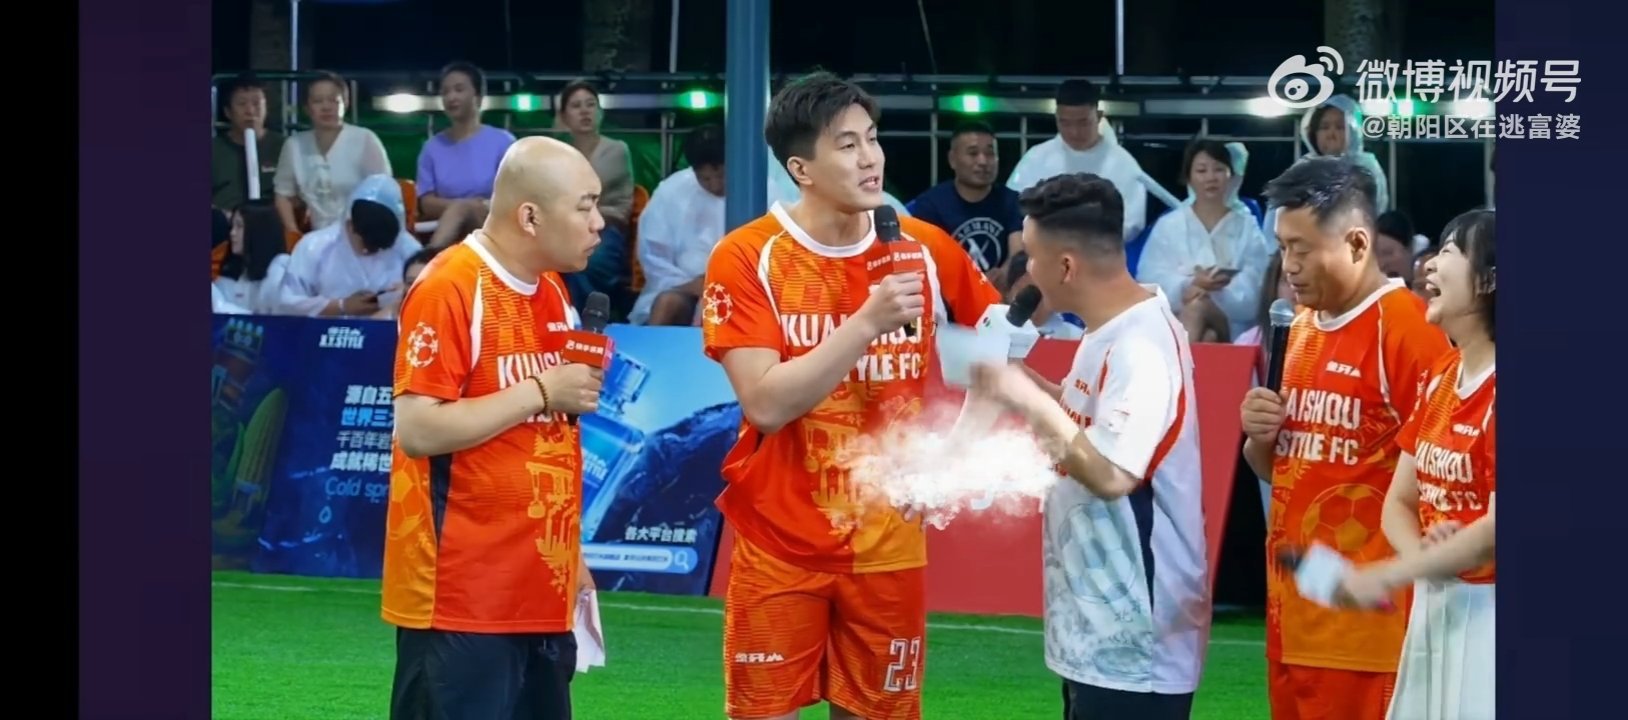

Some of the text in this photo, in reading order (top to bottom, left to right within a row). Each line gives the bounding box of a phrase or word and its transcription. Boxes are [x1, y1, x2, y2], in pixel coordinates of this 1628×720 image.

[898, 353, 921, 380] FC
[1283, 387, 1361, 430] AISHOU
[1329, 437, 1358, 465] FC
[1415, 440, 1473, 483] AISHOU
[325, 476, 361, 497] Cold
[883, 636, 921, 692] 23
